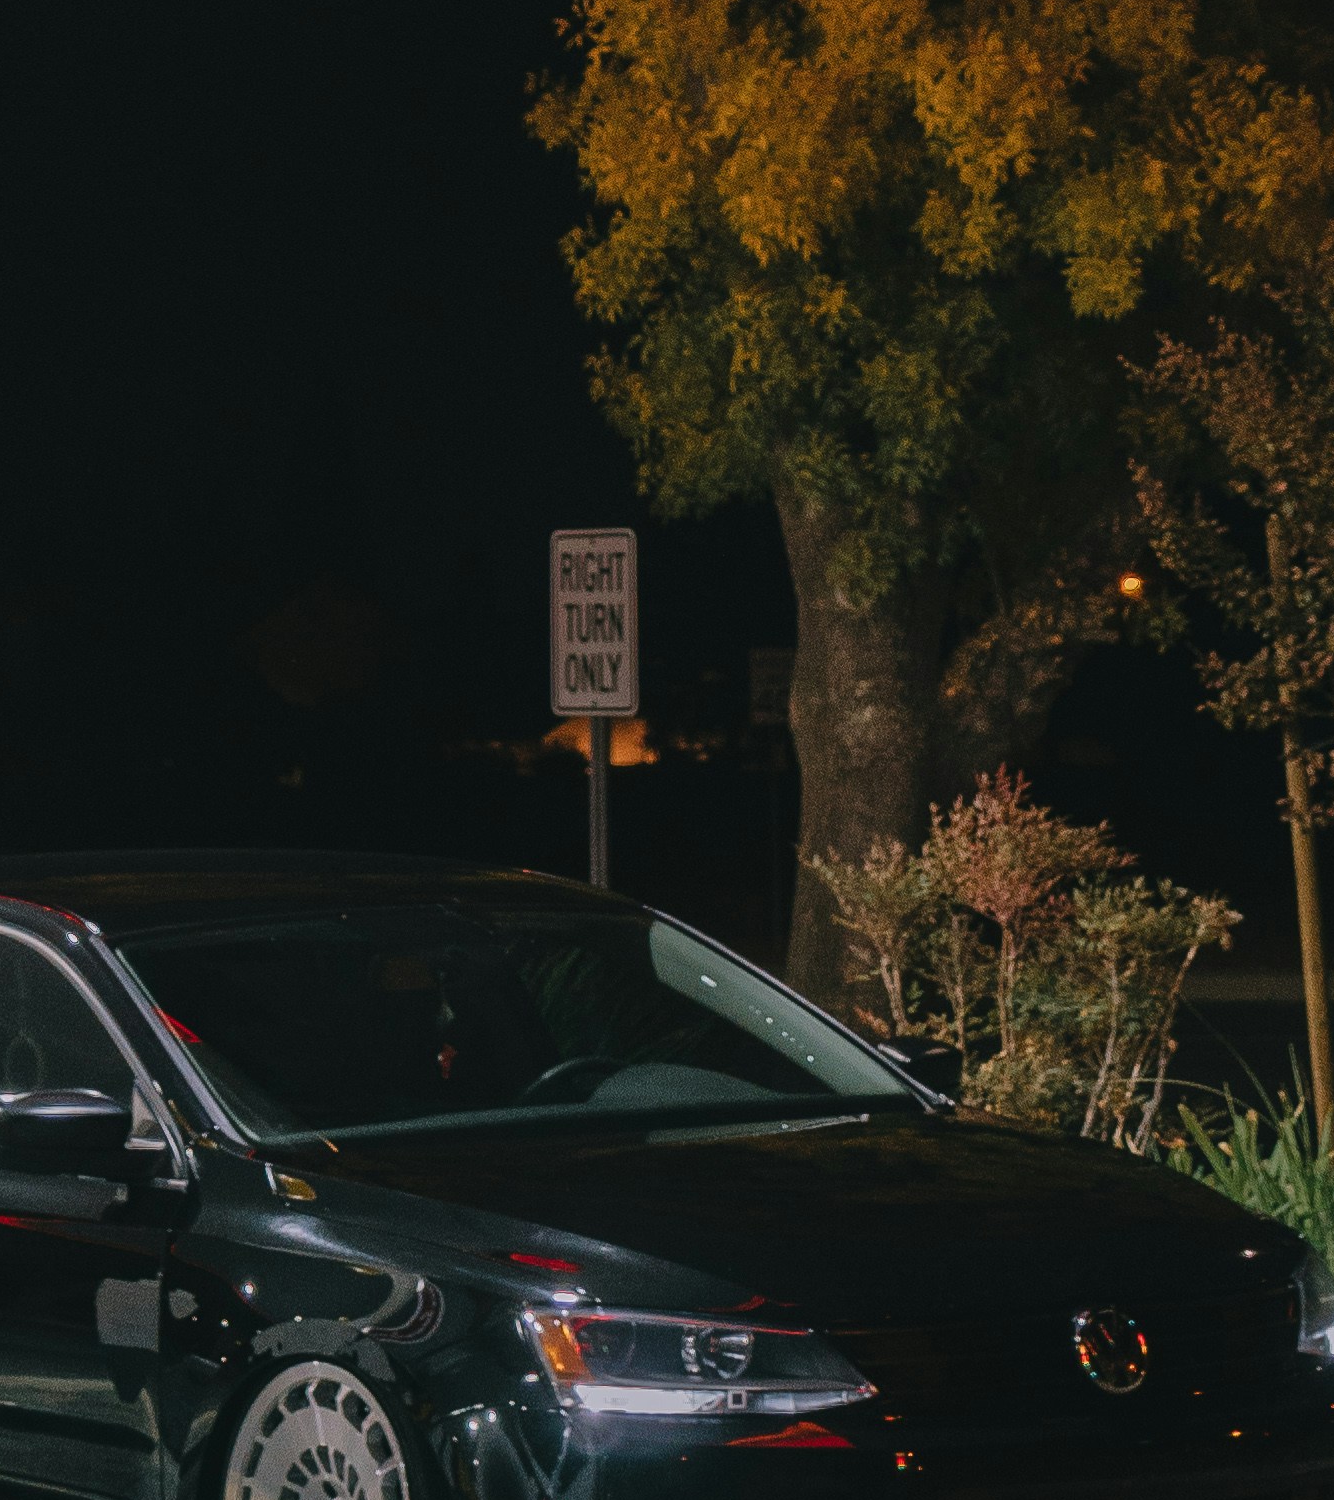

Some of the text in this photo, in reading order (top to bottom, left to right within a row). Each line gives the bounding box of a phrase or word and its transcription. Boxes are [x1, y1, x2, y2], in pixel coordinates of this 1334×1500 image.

[560, 551, 625, 592] RIGHT
[563, 603, 625, 643] TURN
[564, 652, 622, 693] ONLY
